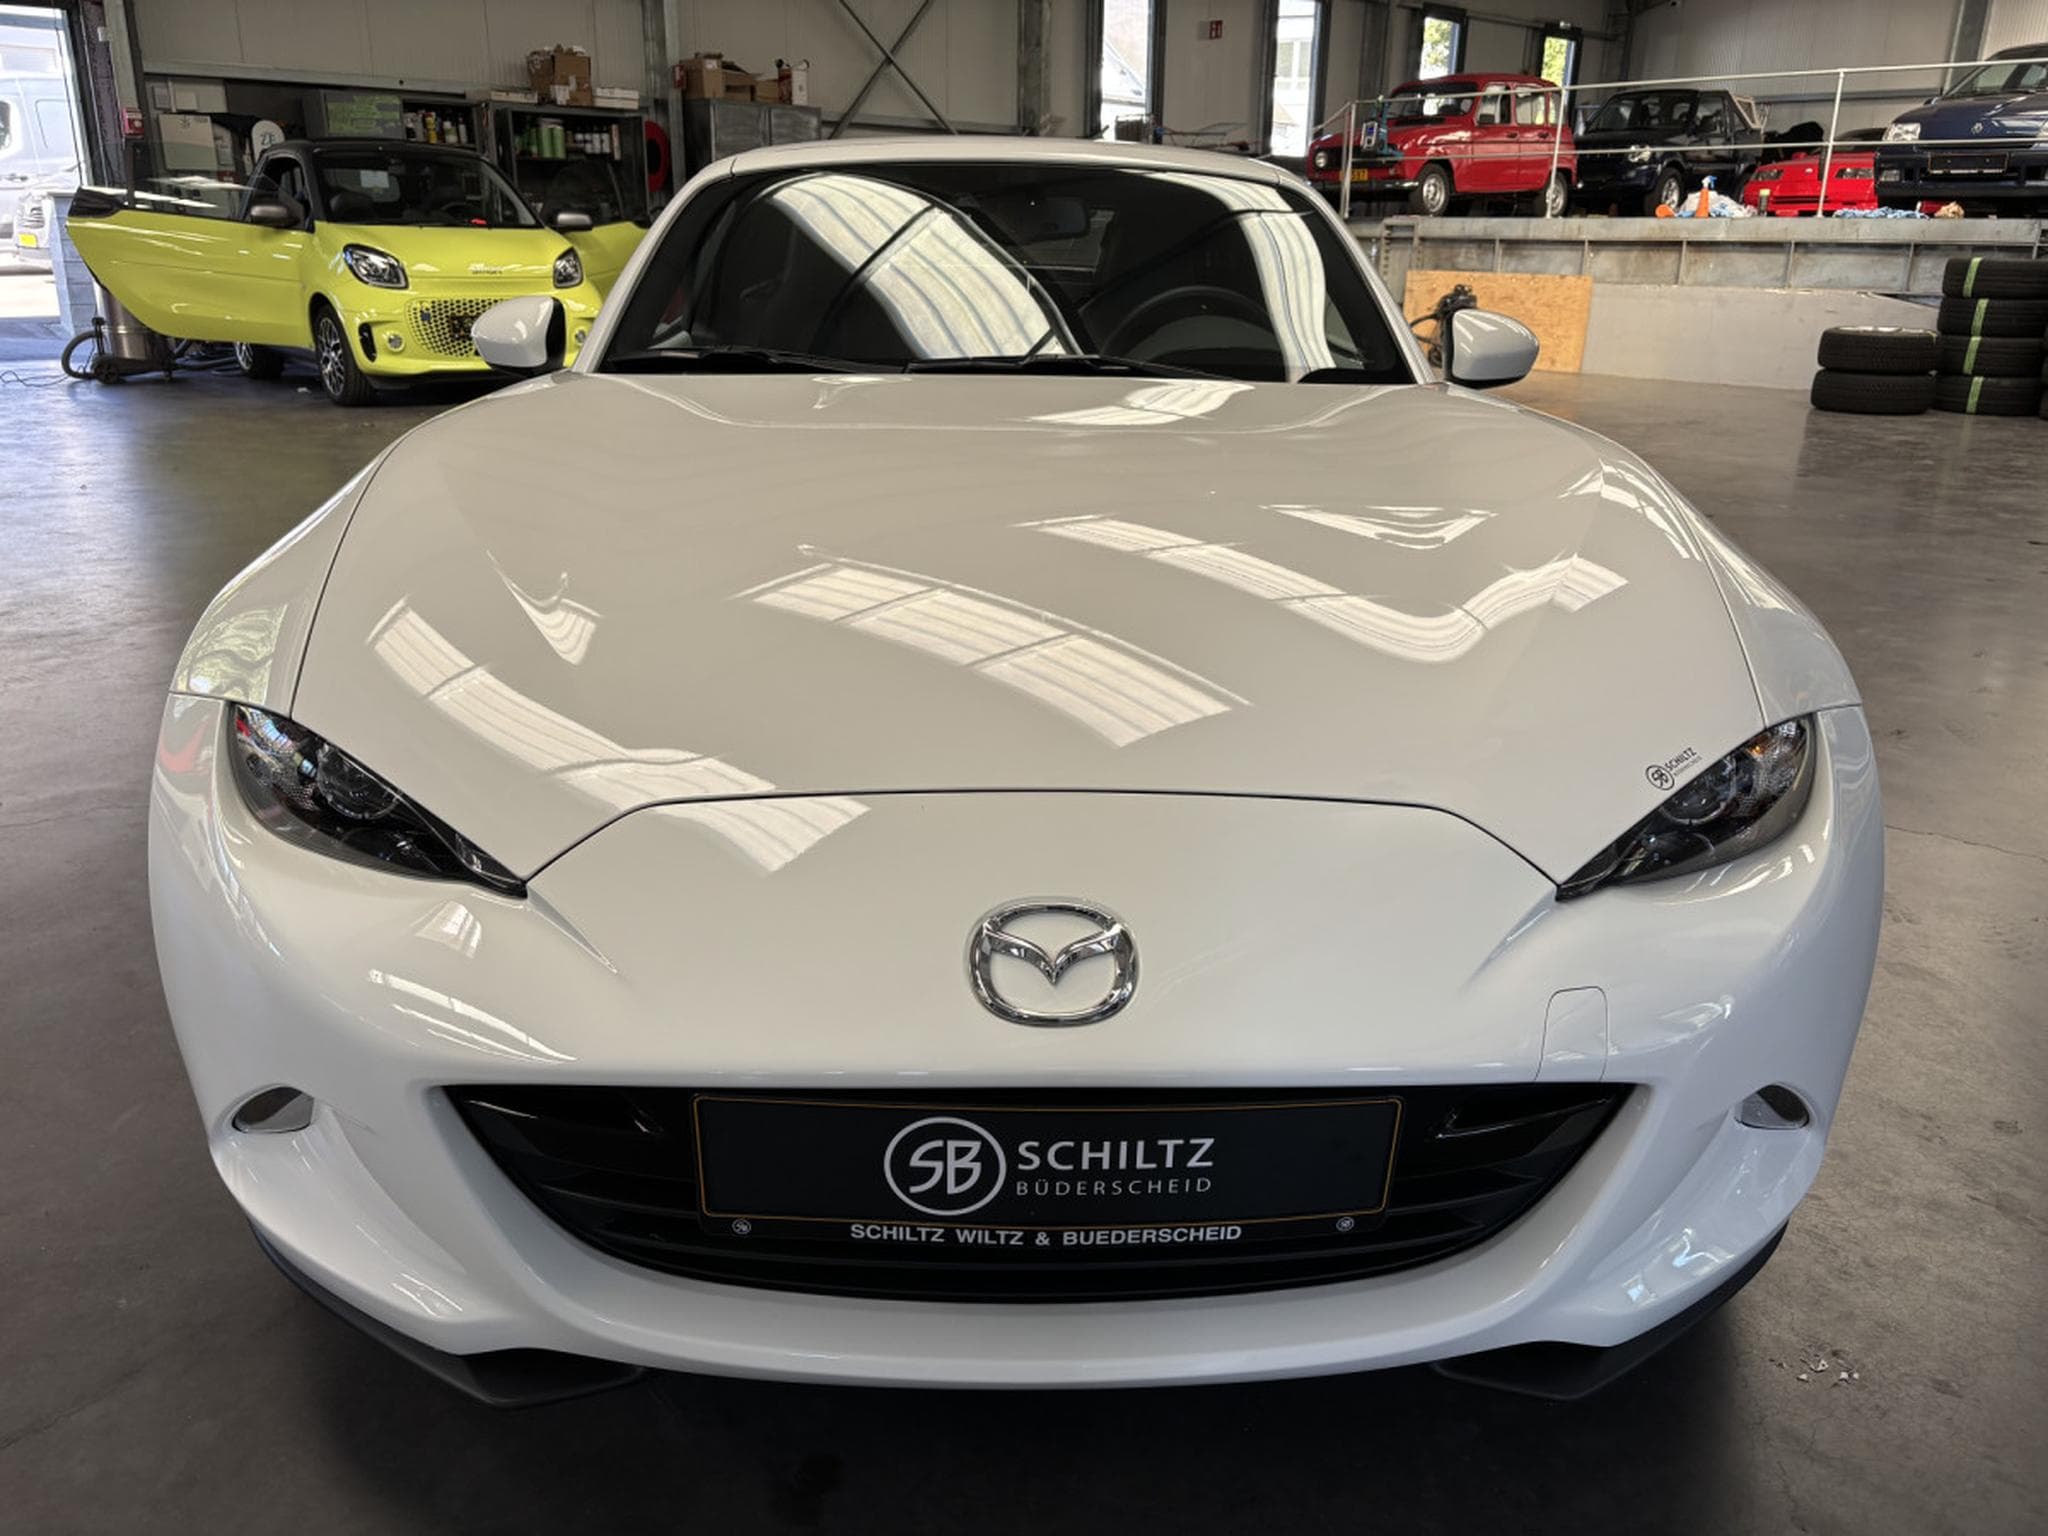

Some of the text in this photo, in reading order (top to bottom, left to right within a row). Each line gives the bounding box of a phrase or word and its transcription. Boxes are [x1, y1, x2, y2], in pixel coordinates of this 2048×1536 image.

[1664, 747, 1697, 771] SCHILTZ
[1017, 1138, 1215, 1171] SCHILTZ
[909, 1139, 982, 1195] SB
[1016, 1177, 1213, 1197] BÜDERSCHEID
[850, 1223, 1242, 1246] SCHILTZ WILTZ & BUEDERSCHEID
